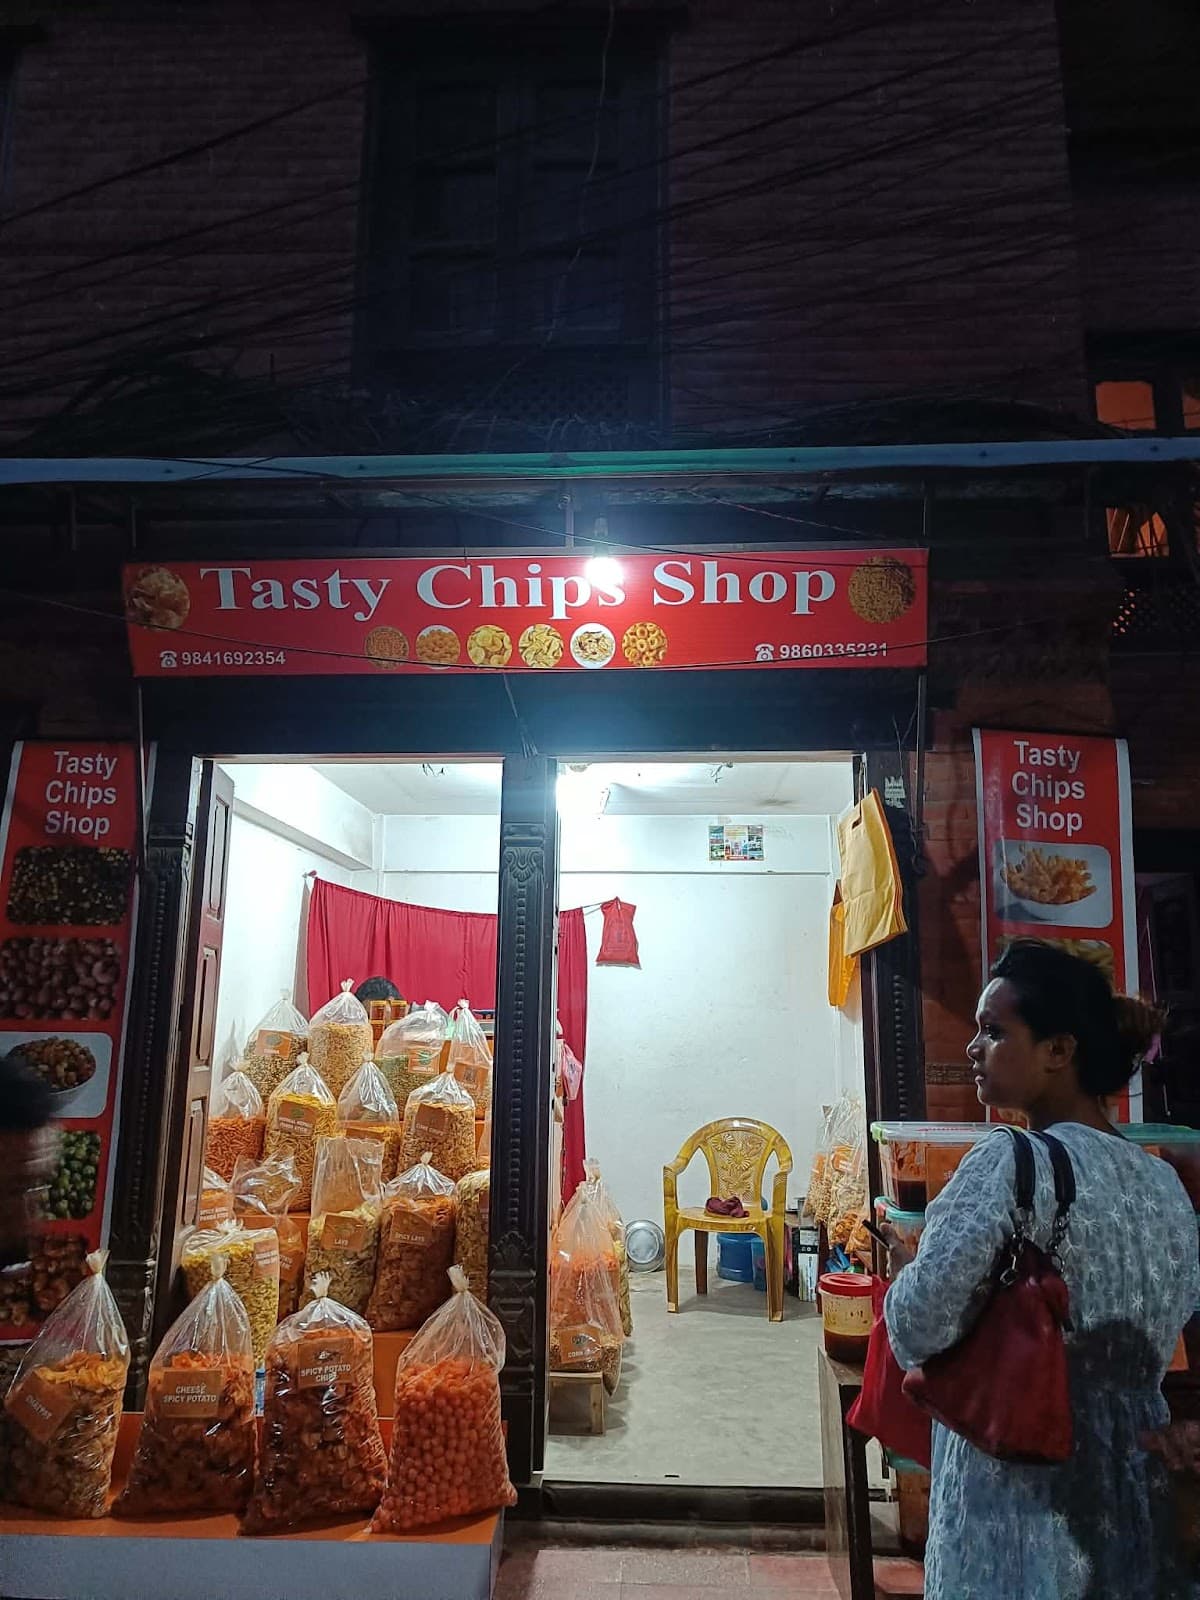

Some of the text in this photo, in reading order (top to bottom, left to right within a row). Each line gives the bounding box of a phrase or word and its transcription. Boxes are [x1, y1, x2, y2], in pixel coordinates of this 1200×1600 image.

[200, 560, 836, 621] Tasty Chips Shop
[181, 651, 286, 665] 9841692354
[54, 750, 118, 780] Tasty
[1013, 740, 1081, 773] Tasty
[45, 780, 117, 809] Chips
[1011, 770, 1086, 804] Chips
[44, 810, 111, 840] Shop
[1016, 803, 1083, 837] Shop
[300, 1364, 351, 1377] SPICY POTATO
[163, 1394, 217, 1403] SPICY POTATO
[175, 1384, 207, 1394] CHEESE
